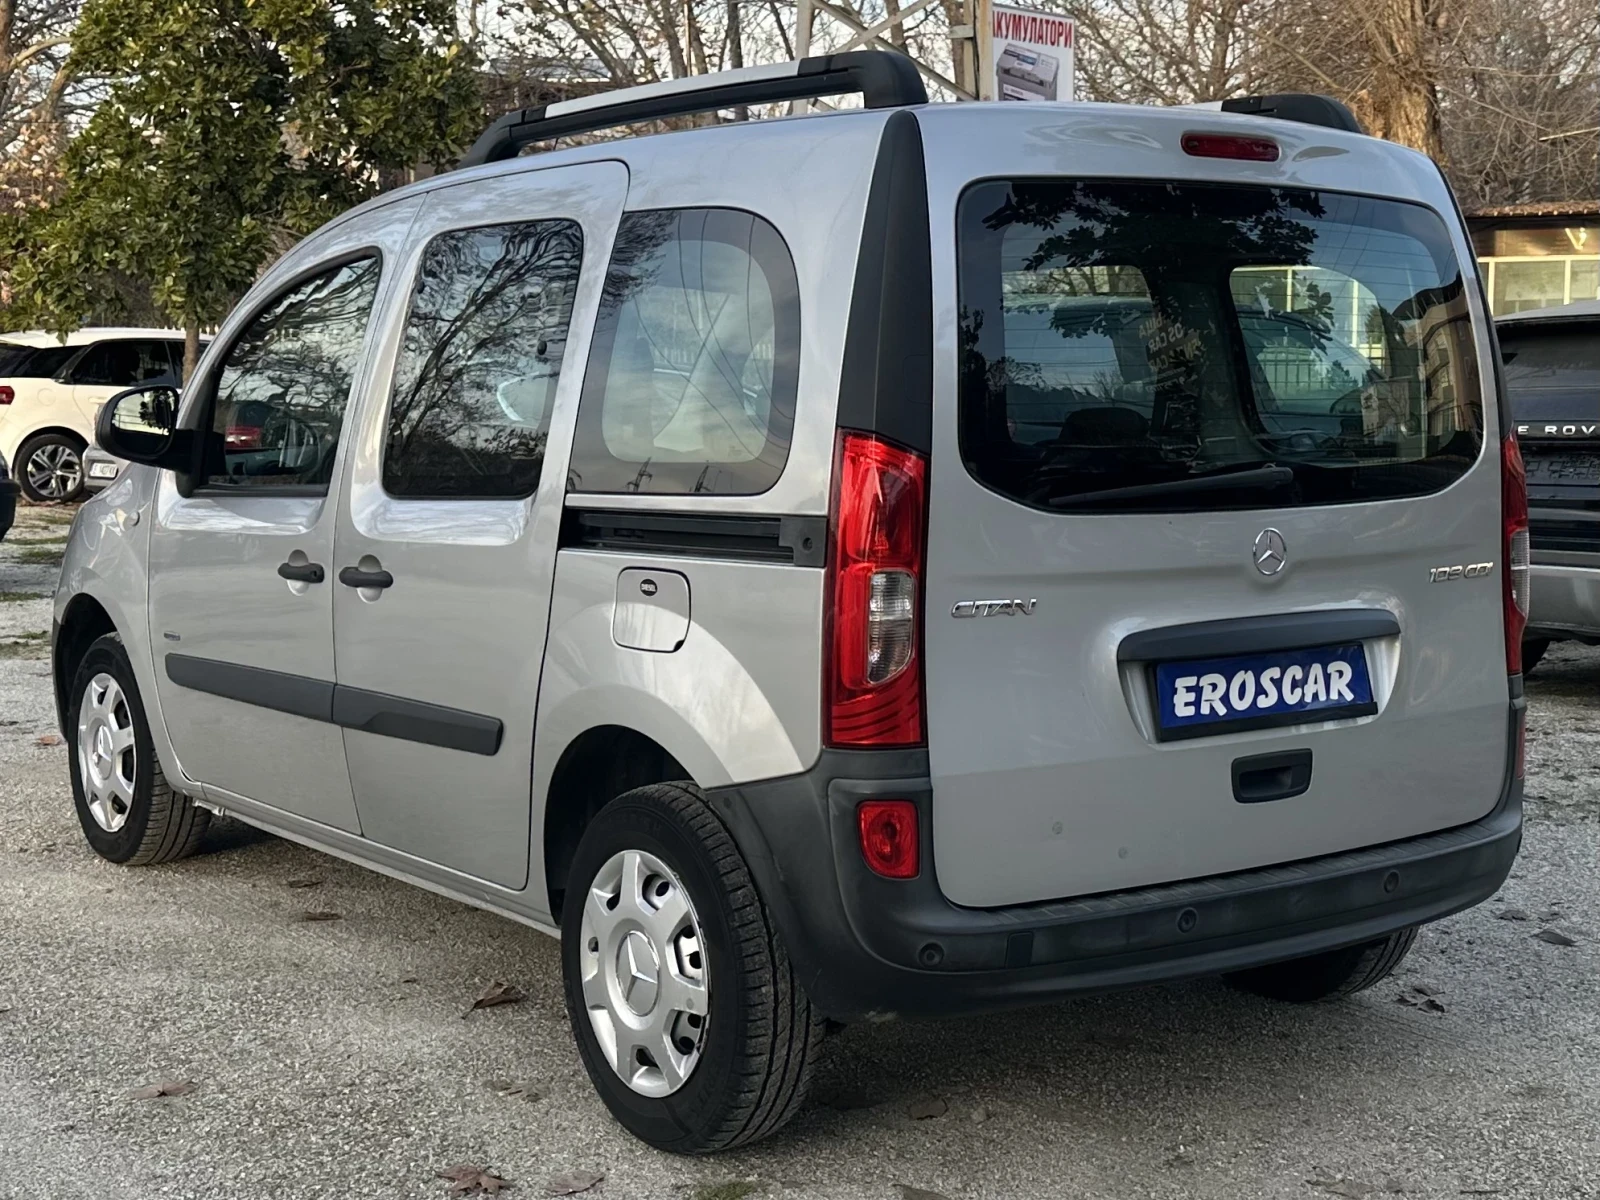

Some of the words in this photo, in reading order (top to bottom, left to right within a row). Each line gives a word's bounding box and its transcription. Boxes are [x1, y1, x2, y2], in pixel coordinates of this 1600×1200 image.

[1544, 425, 1597, 435] ROV
[951, 598, 1037, 618] CITAN
[1173, 661, 1355, 717] EROSCAR
